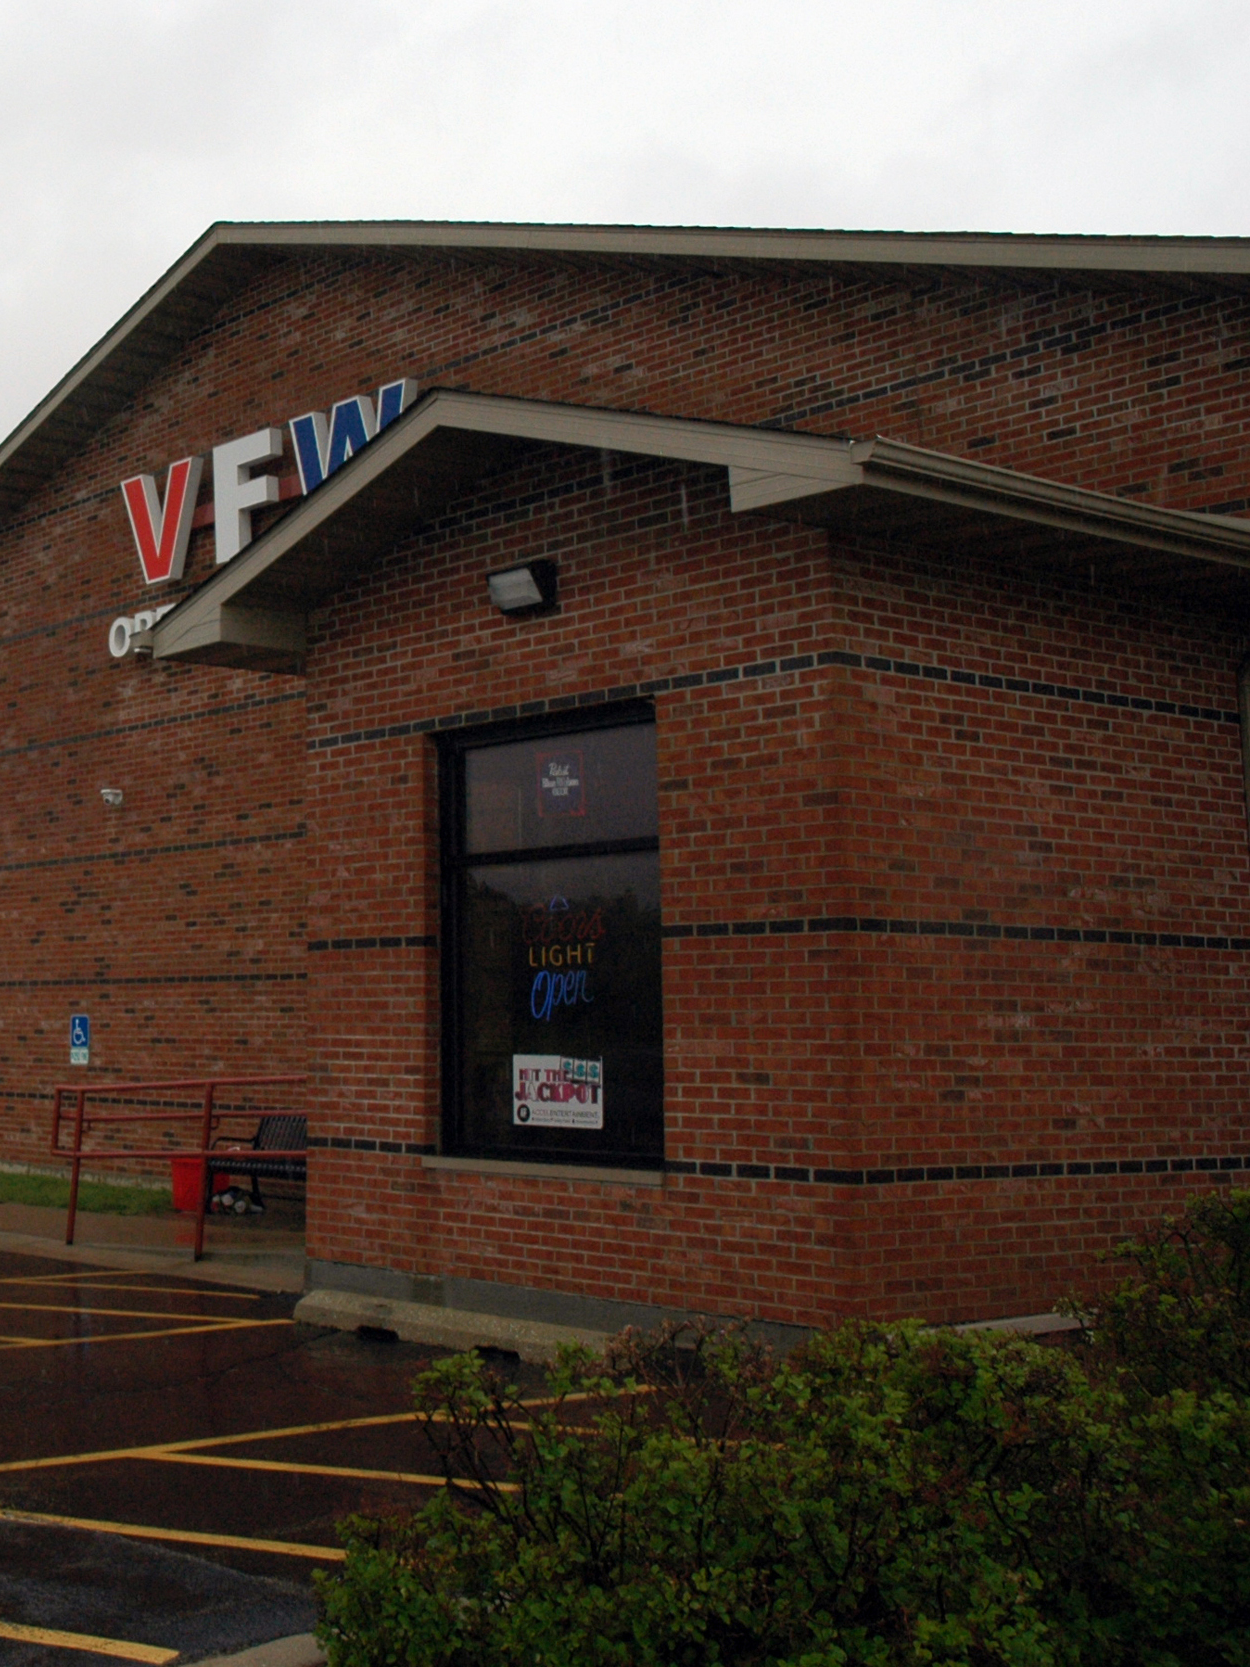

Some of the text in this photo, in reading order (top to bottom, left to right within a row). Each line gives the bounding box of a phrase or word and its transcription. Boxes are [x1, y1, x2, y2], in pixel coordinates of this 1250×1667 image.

[120, 378, 417, 585] VFW
[528, 942, 596, 968] LIGHT
[530, 970, 595, 1022] Open
[519, 1068, 570, 1083] HIT THE
[514, 1081, 601, 1105] JACKPOT
